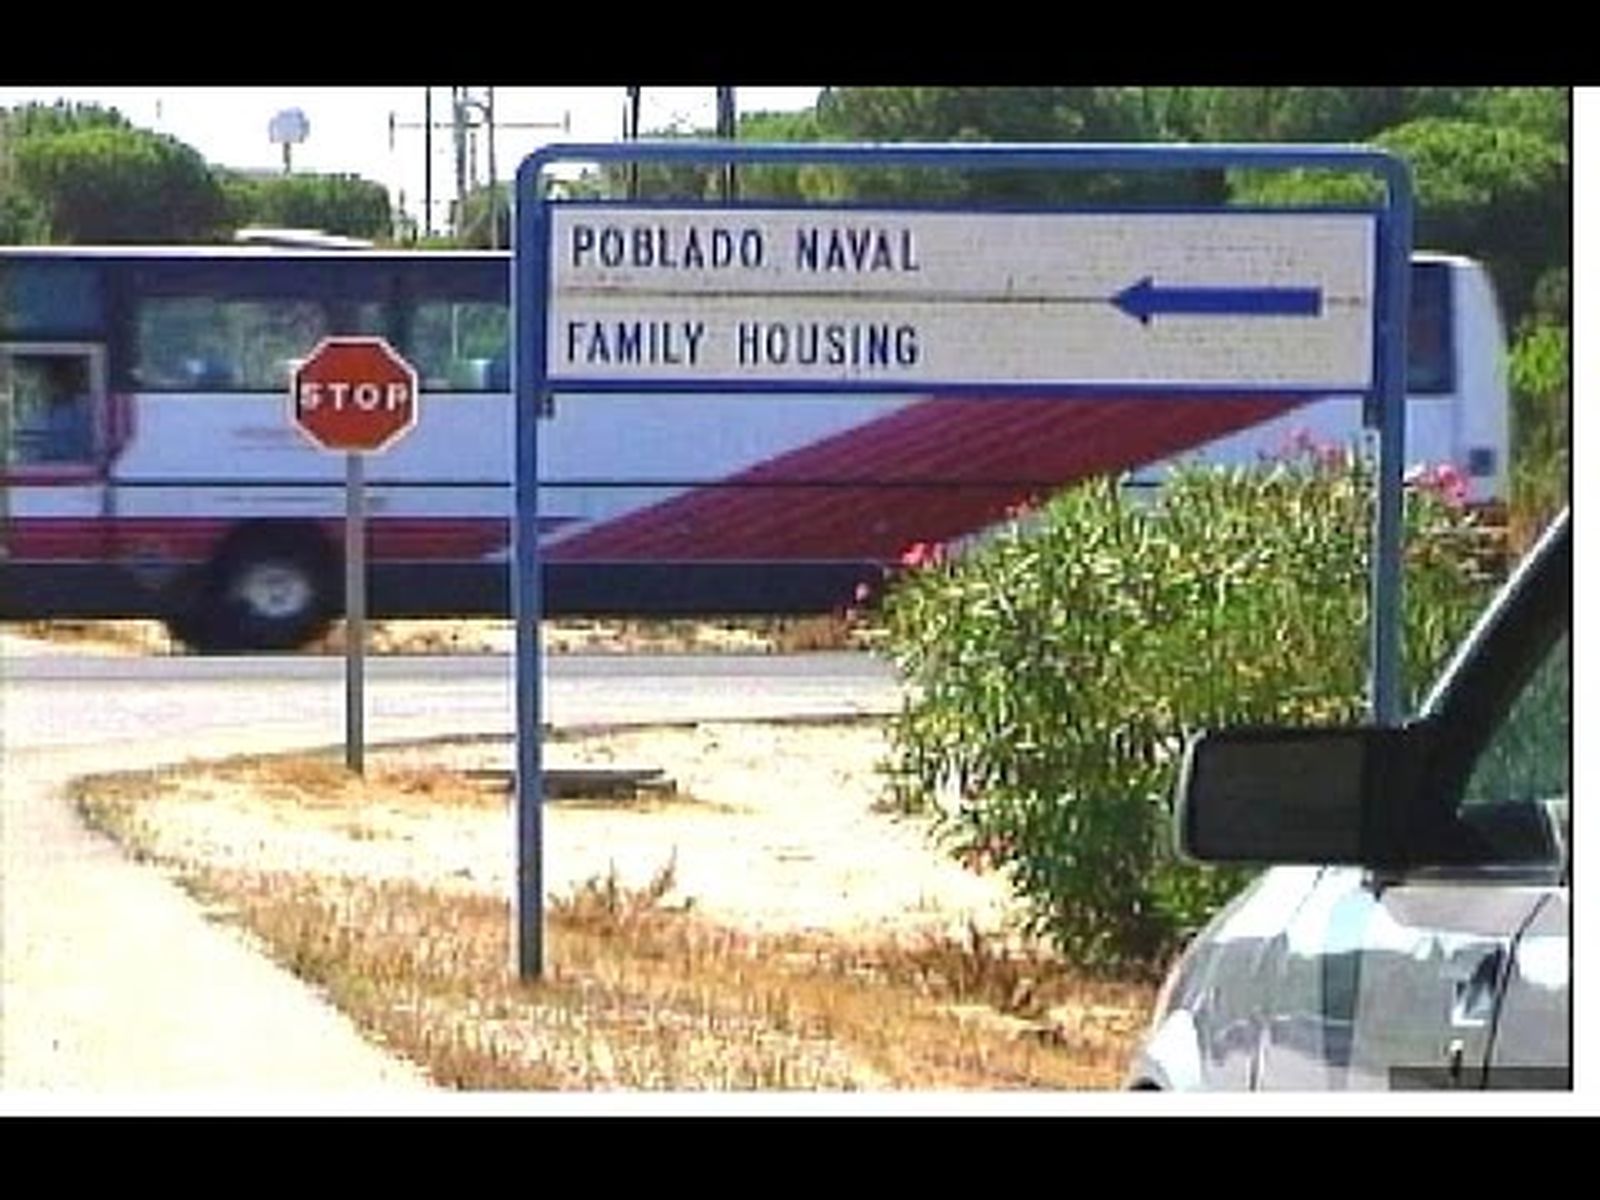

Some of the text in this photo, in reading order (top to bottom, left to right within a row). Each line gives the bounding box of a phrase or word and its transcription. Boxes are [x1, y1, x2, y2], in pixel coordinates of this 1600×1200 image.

[571, 225, 921, 272] POBLADO NAVAL
[566, 322, 920, 366] FAMILY HOUSING
[300, 381, 408, 411] STOP
